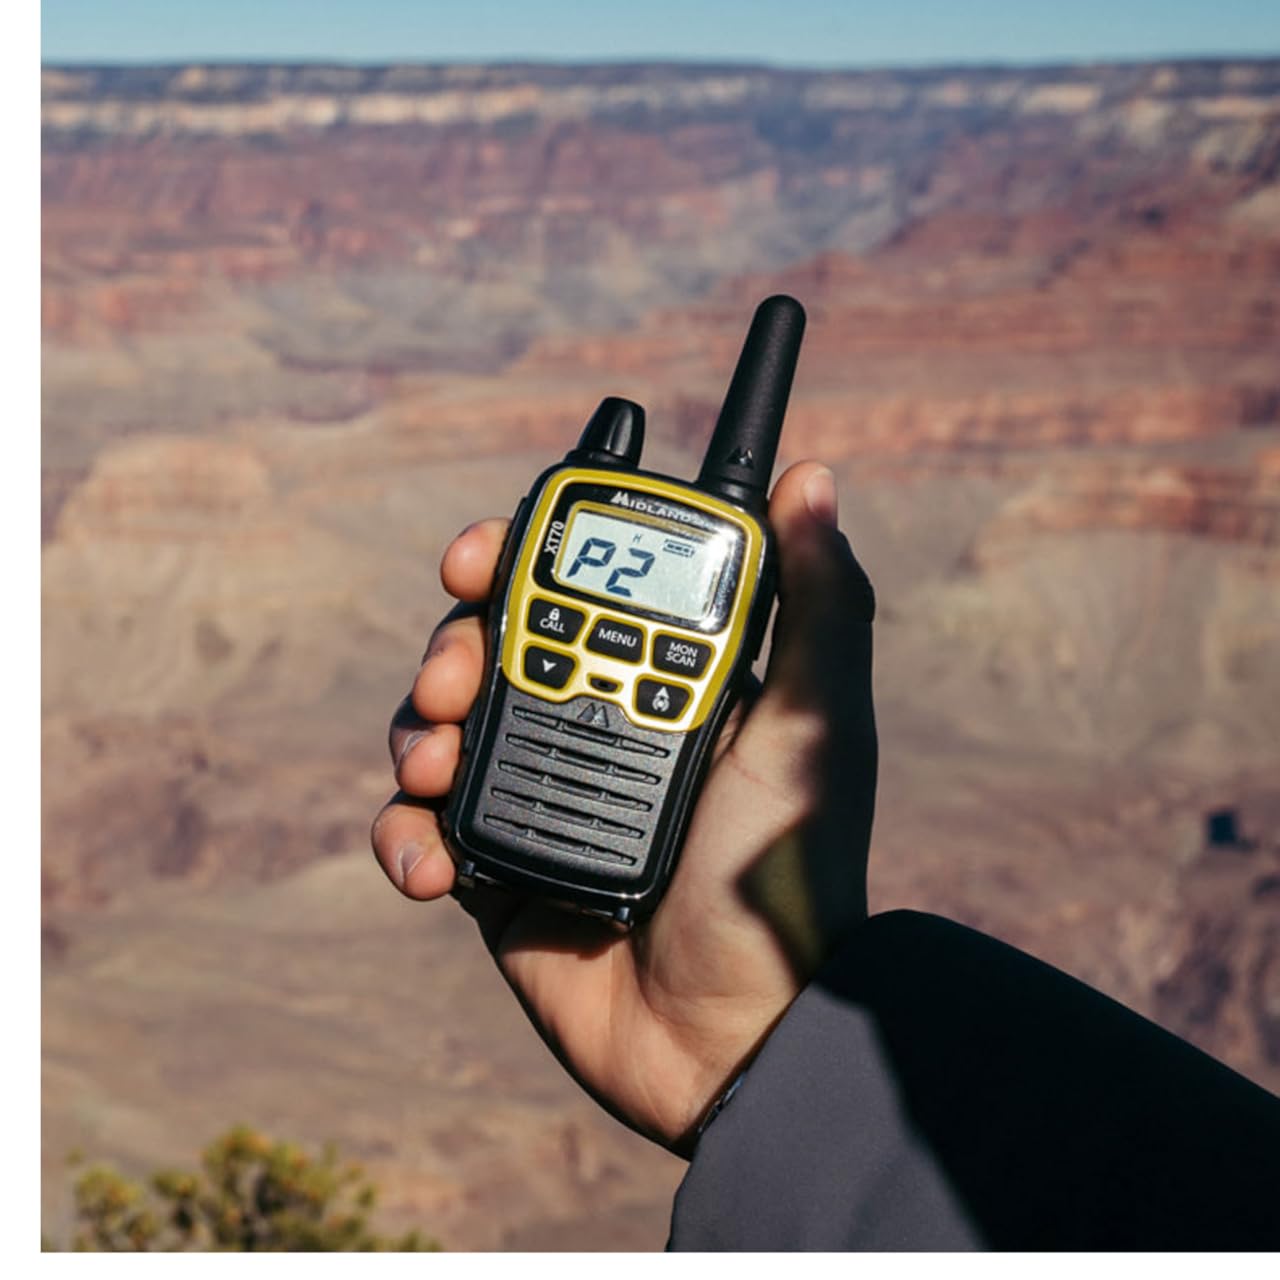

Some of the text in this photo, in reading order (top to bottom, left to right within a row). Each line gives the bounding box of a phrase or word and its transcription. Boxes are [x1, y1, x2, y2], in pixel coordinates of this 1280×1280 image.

[544, 520, 565, 554] XT70
[539, 617, 565, 634] CALL
[598, 627, 637, 648] MENU
[669, 641, 698, 657] MON
[665, 653, 696, 668] SCAN
